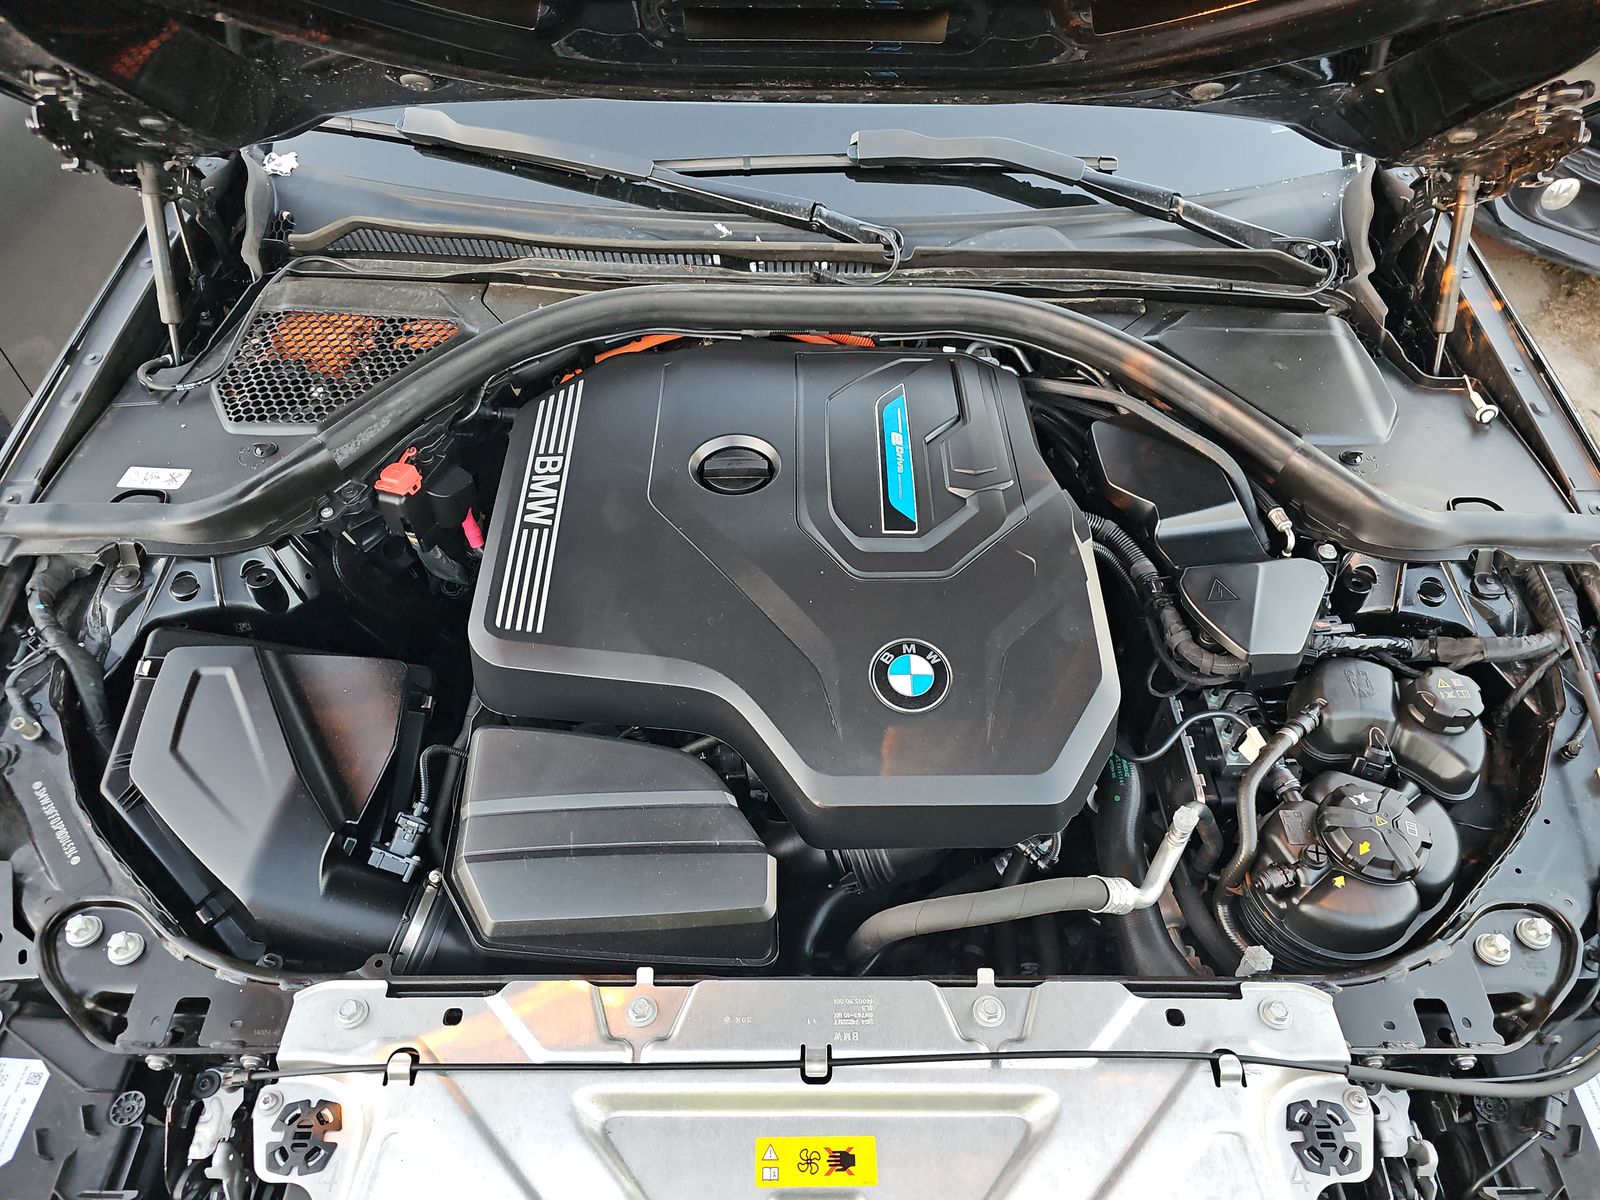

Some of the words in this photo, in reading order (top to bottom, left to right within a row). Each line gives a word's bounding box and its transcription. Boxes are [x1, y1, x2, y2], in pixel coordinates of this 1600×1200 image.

[523, 455, 564, 526] BMW
[880, 643, 941, 665] BMW
[834, 1031, 859, 1041] BMW
